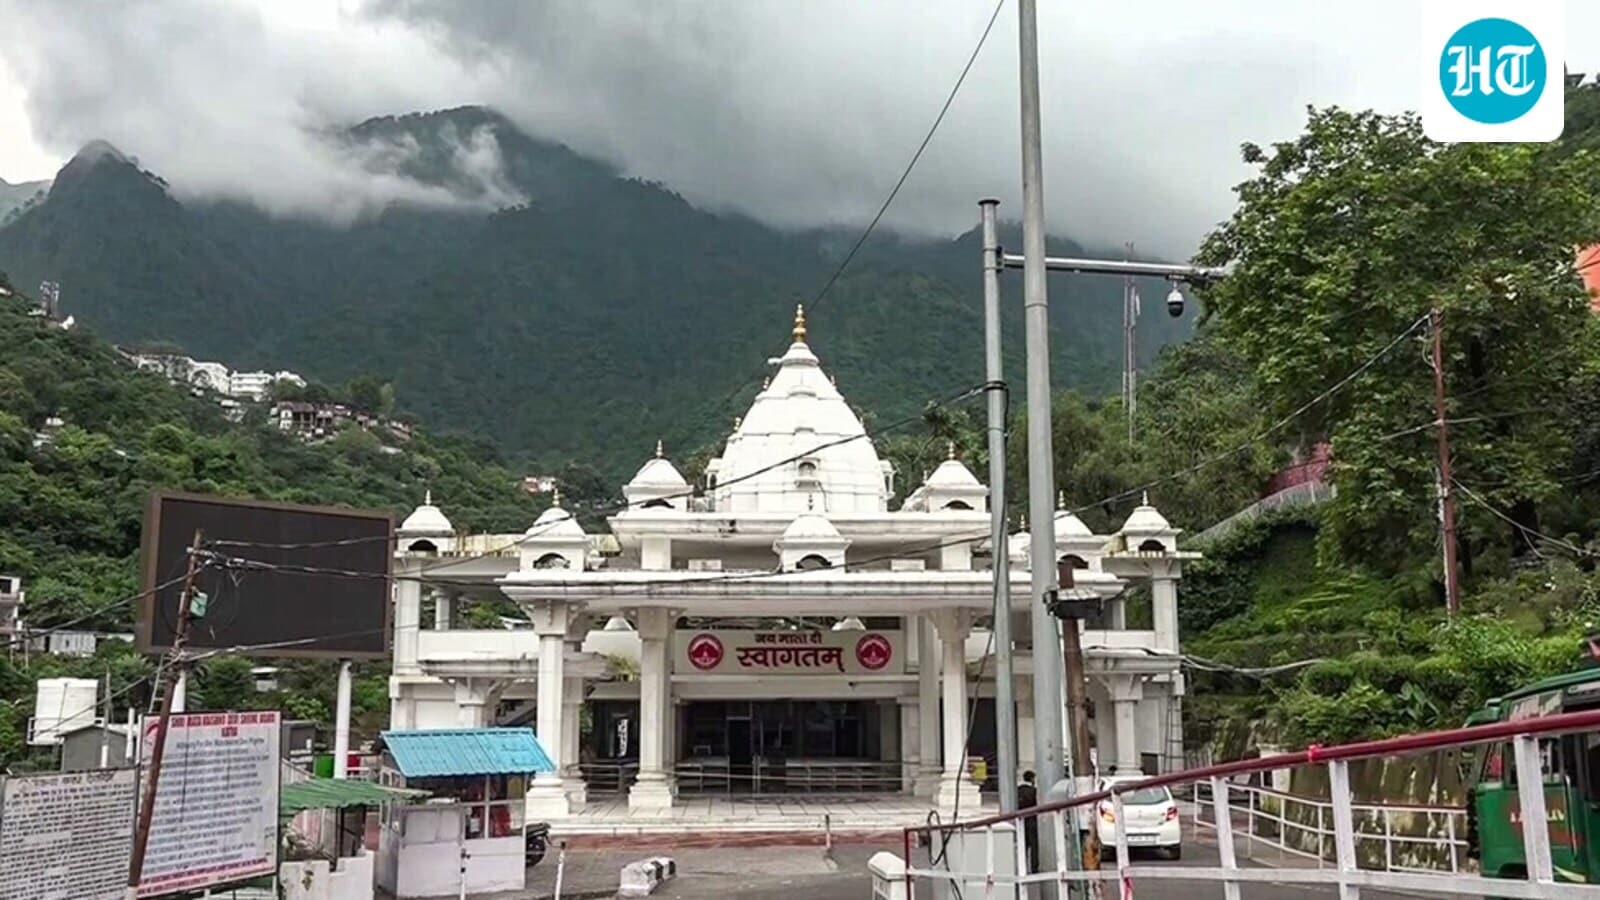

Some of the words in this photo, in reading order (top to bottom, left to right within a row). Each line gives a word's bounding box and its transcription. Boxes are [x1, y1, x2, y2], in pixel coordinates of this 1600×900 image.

[754, 632, 776, 645] जय
[778, 632, 807, 645] माता
[810, 630, 822, 645] दी
[736, 646, 845, 673] स्वागतम्
